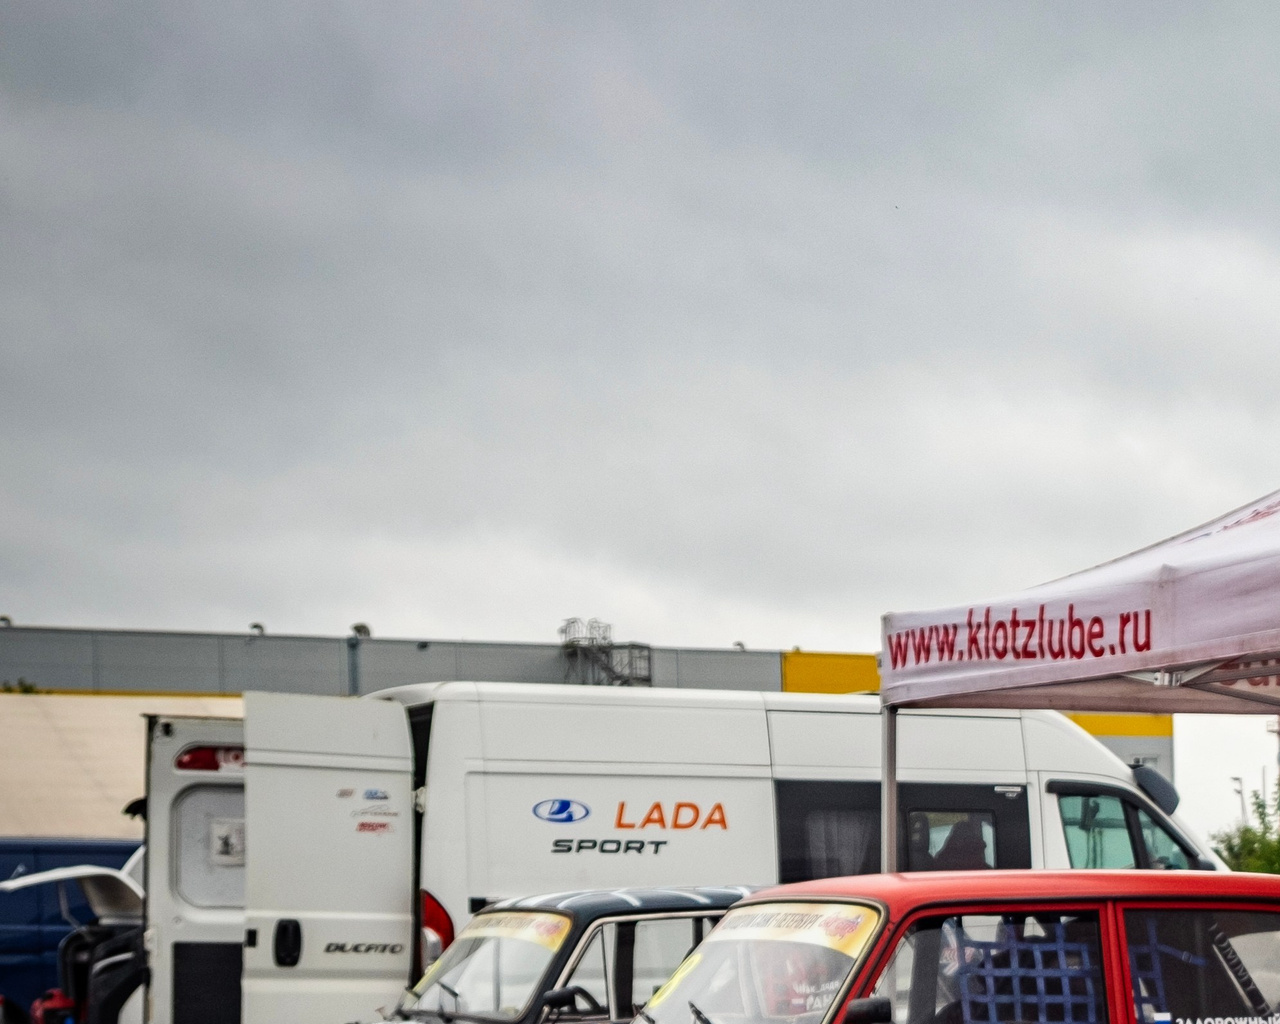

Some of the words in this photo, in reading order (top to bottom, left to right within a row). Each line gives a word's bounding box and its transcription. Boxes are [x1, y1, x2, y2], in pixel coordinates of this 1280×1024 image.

[887, 603, 1151, 670] www.klotzlube.ru
[614, 801, 728, 830] LADA
[551, 839, 667, 855] SPORT
[324, 943, 403, 954] DUCATO
